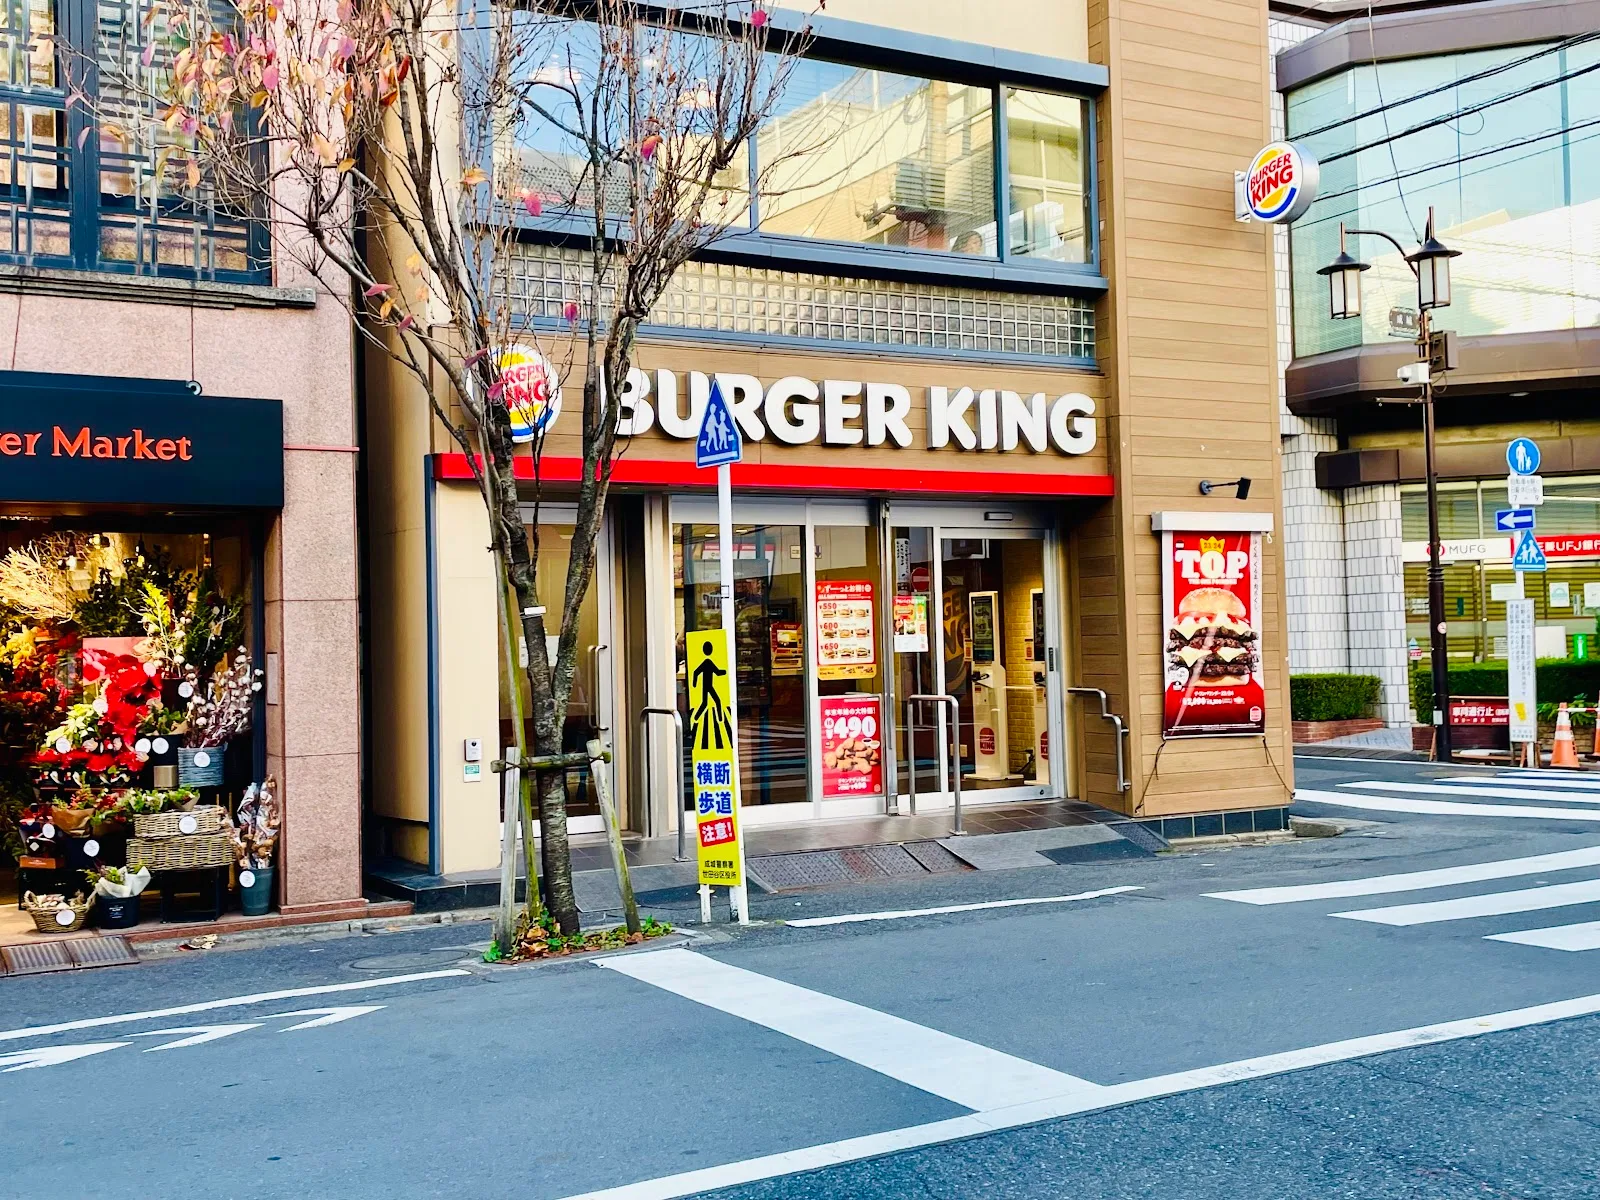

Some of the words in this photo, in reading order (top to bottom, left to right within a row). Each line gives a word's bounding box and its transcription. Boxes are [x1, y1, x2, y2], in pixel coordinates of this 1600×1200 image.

[1250, 153, 1292, 191] BURGER
[1251, 164, 1293, 208] KING
[599, 365, 913, 448] BURGER
[928, 385, 1097, 455] KING
[0, 432, 42, 456] er
[51, 425, 193, 461] Market
[1448, 544, 1487, 555] MUFG
[819, 602, 837, 610] ¥550
[696, 762, 731, 785] 横断
[698, 791, 732, 814] 歩道
[701, 821, 733, 843] 注意!
[702, 869, 737, 879] 世田谷区役所
